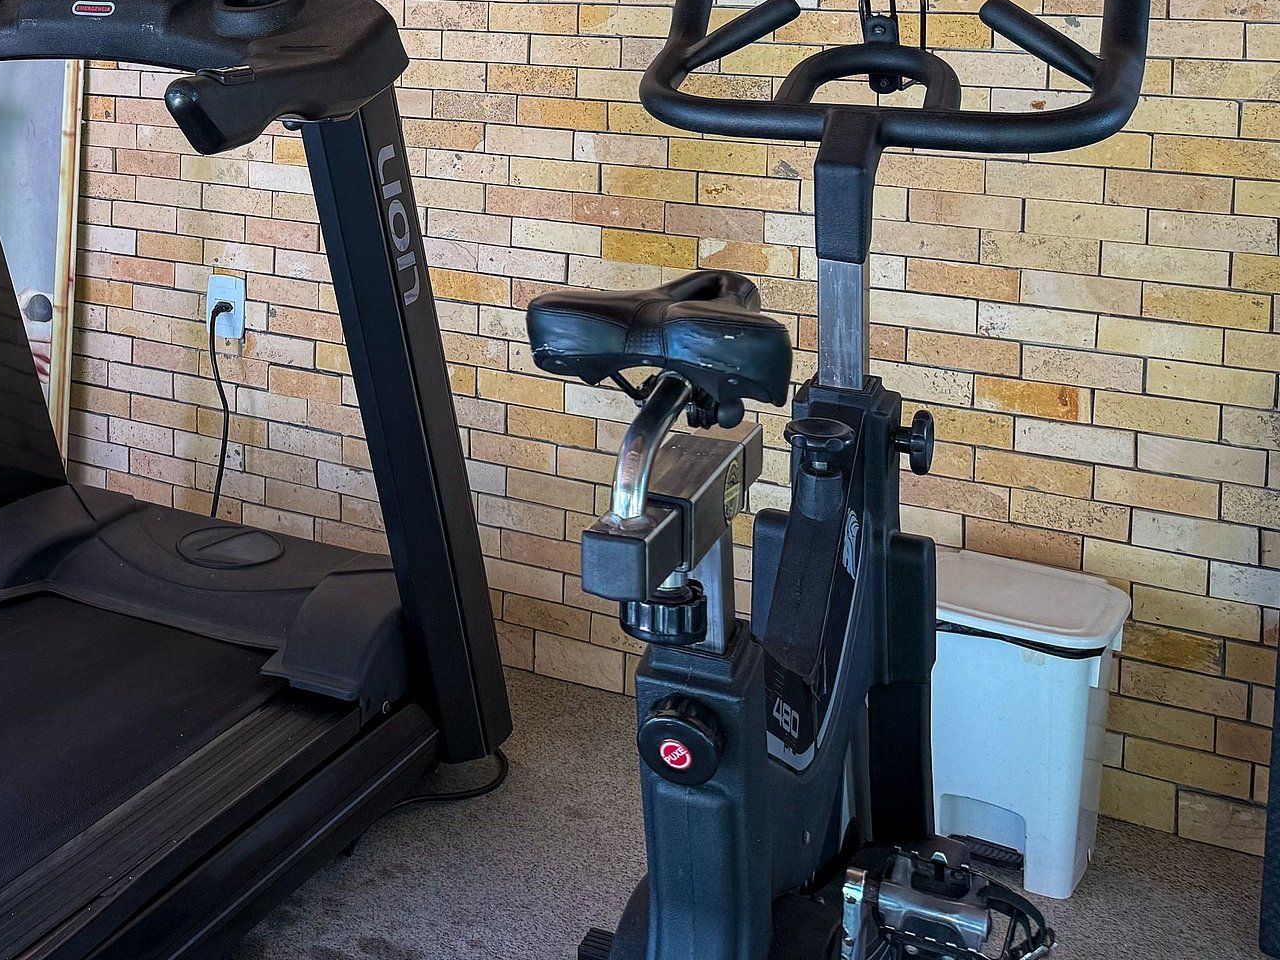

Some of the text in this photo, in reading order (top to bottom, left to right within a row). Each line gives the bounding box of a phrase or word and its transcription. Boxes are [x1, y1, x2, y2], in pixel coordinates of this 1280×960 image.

[377, 143, 421, 307] LION
[772, 696, 801, 739] 480
[663, 744, 688, 765] PUXE
